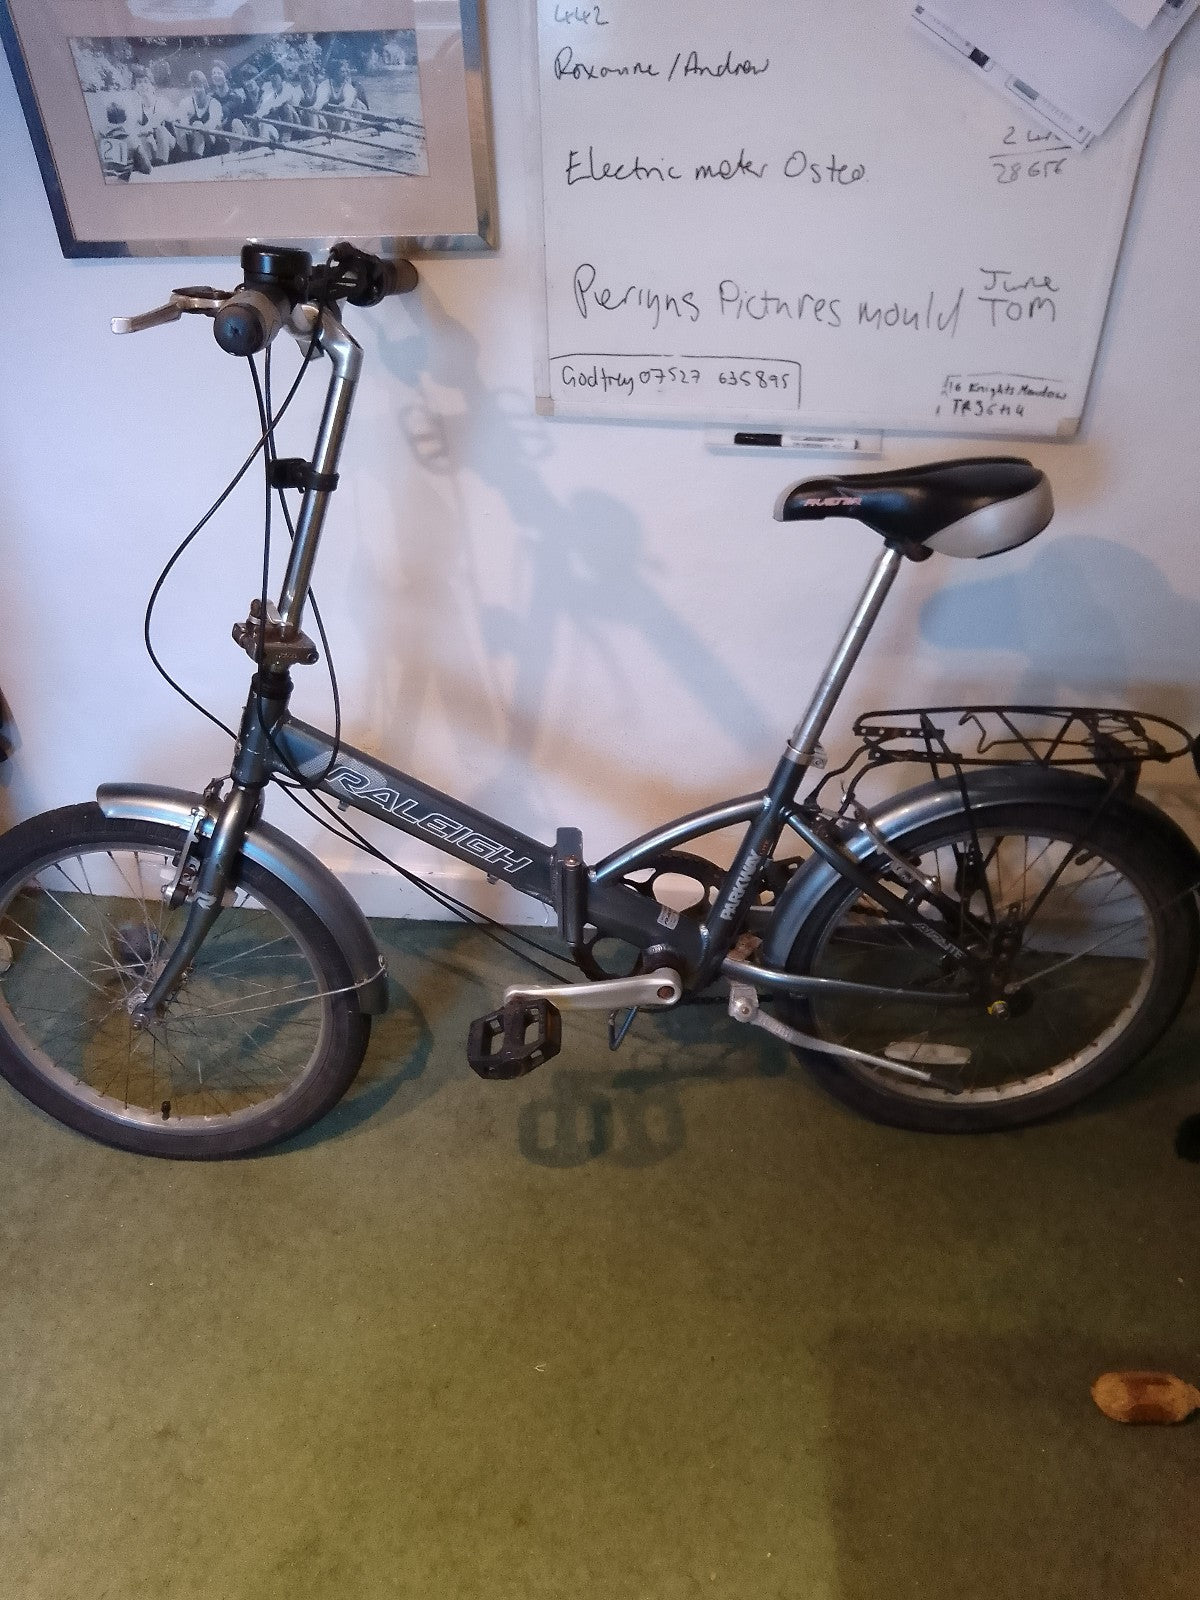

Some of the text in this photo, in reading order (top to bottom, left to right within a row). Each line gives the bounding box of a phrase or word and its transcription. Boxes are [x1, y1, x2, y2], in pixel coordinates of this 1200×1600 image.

[566, 146, 682, 185] Electric
[719, 279, 842, 327] Pictures
[562, 365, 635, 396] Godfrey
[639, 366, 701, 385] 07527
[325, 766, 533, 874] RALEIGH
[719, 848, 762, 921] PARKWAY
